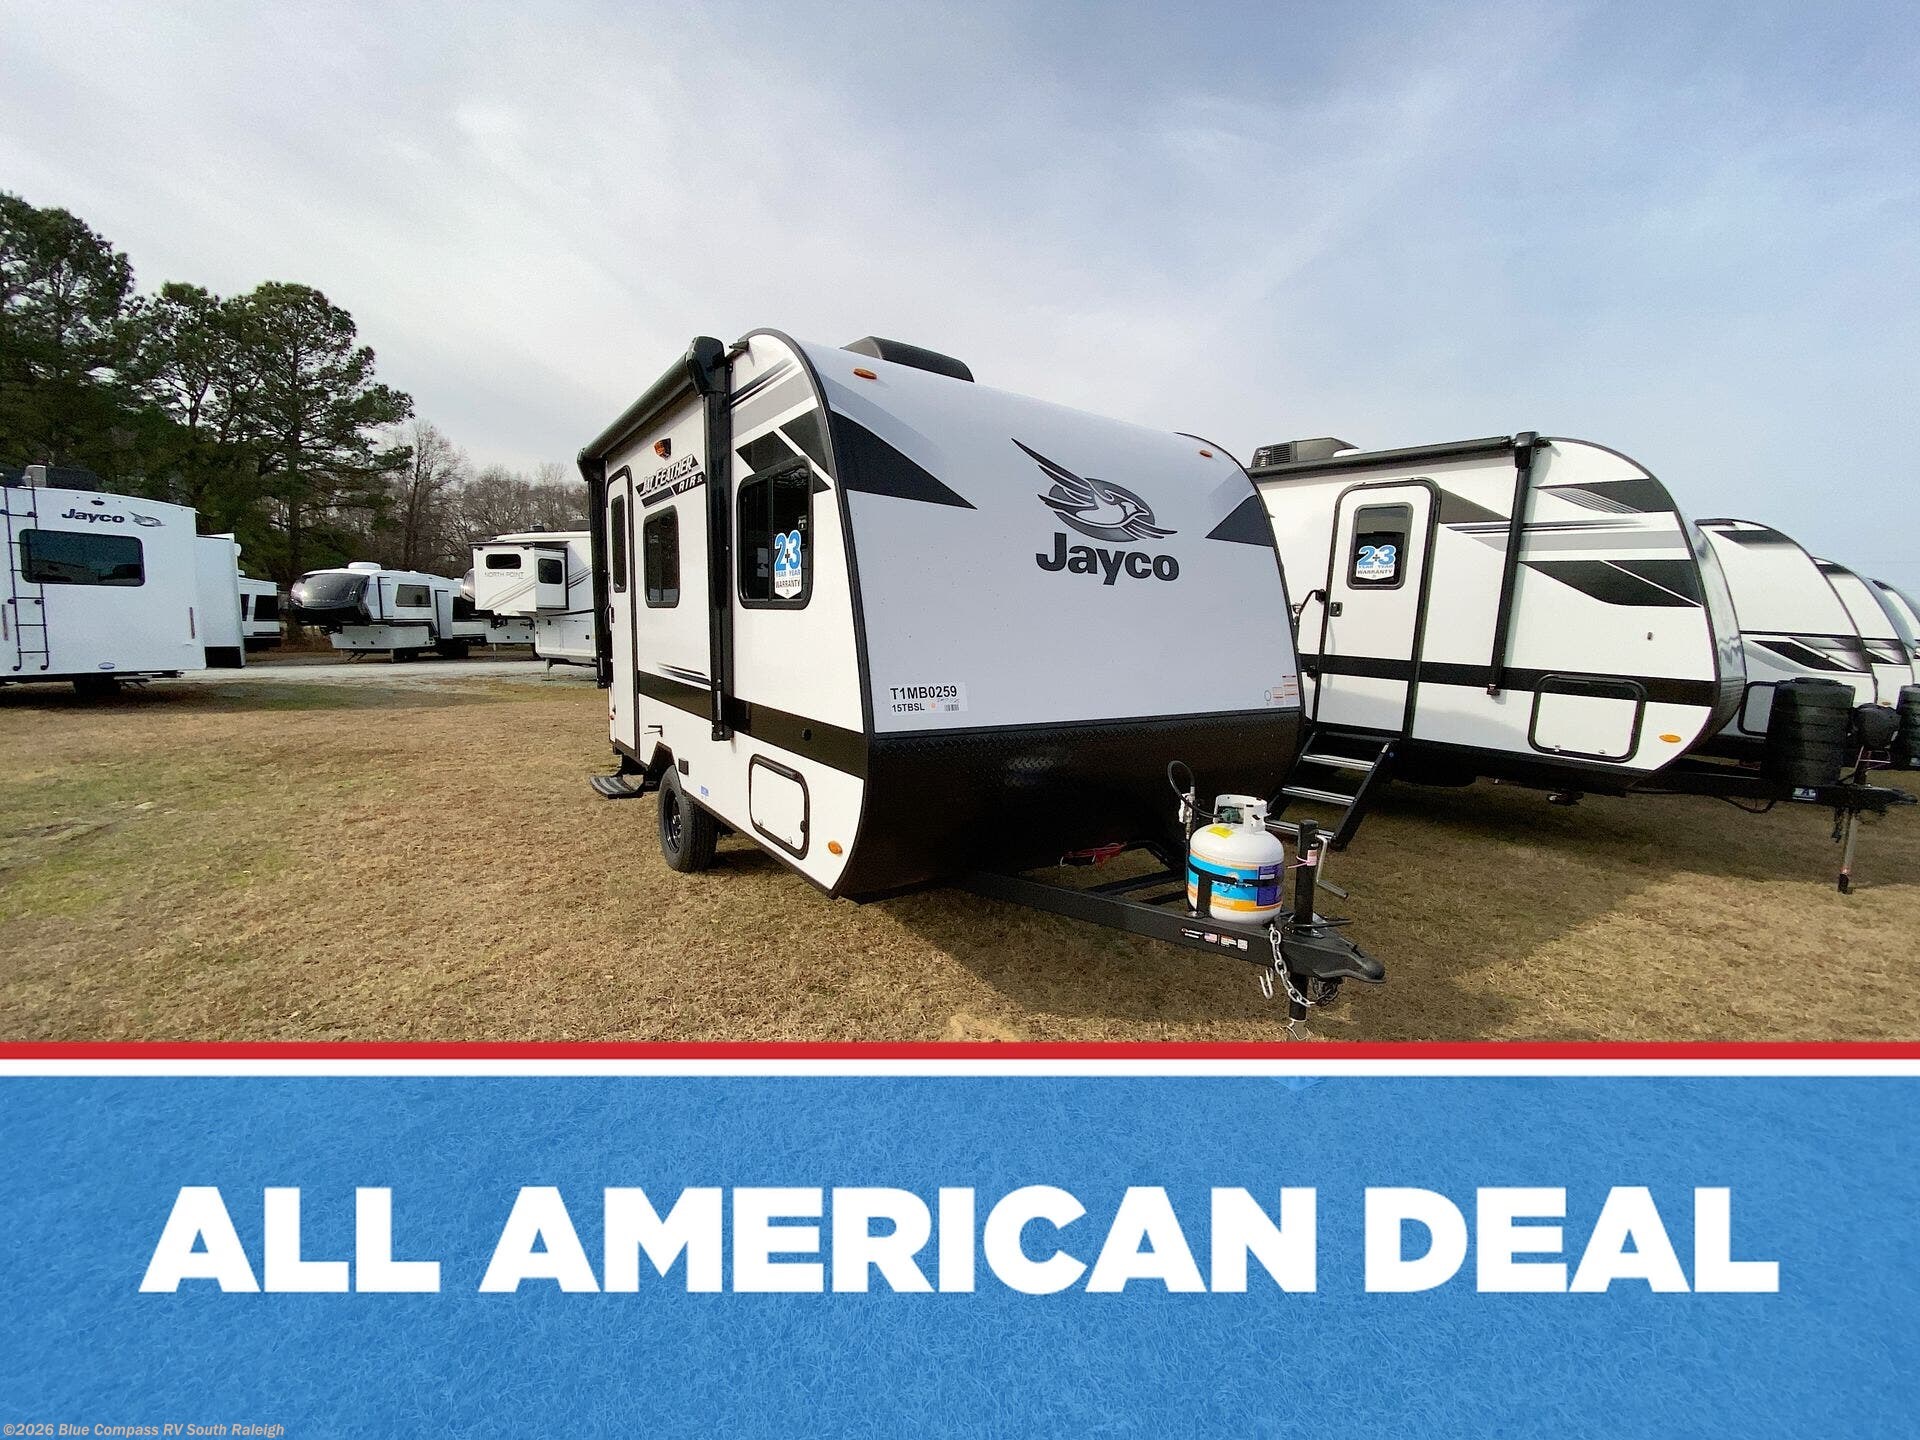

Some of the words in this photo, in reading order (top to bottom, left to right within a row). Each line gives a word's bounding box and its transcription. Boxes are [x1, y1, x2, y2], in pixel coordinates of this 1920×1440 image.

[655, 454, 694, 490] FEATHER
[678, 475, 697, 493] AIR
[61, 508, 125, 524] Jayco
[1035, 532, 1180, 586] Jayco
[775, 579, 801, 589] WARRANTY
[889, 685, 957, 700] T1MB0259
[891, 702, 926, 713] 15TBSL
